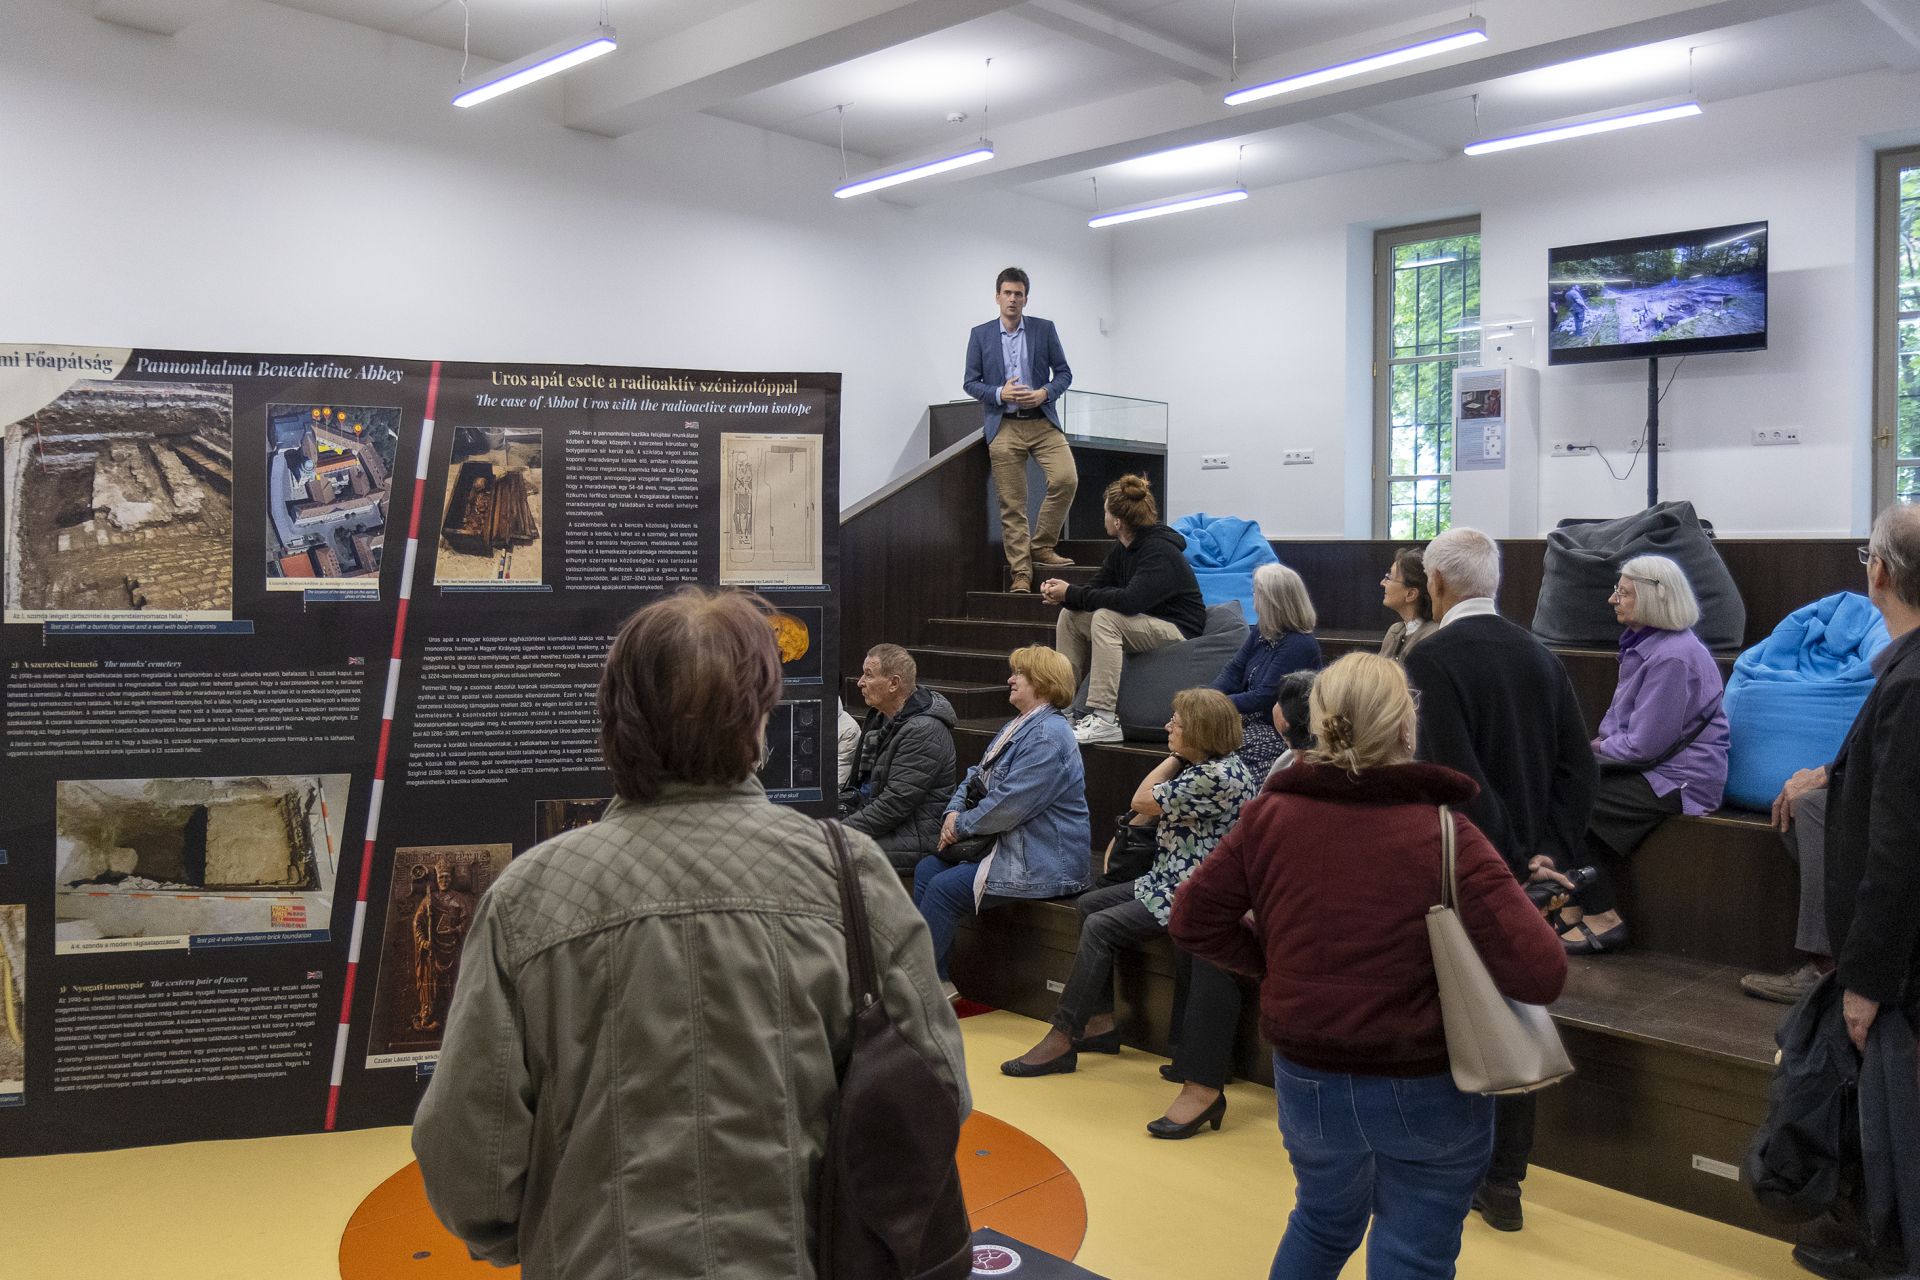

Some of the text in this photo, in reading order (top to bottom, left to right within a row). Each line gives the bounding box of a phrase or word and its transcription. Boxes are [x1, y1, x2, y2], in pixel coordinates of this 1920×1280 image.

[26, 351, 112, 374] Főapátság
[136, 357, 403, 384] Pannonhalma Benedictine Abbey
[492, 371, 798, 397] Uros apát esete a radioaktív szénizotóppal
[476, 394, 812, 418] The case of Abbot Uros with the radioactive carbon isotope
[148, 660, 181, 669] cemetery
[151, 979, 164, 987] The
[196, 976, 212, 987] pair
[214, 976, 223, 984] of
